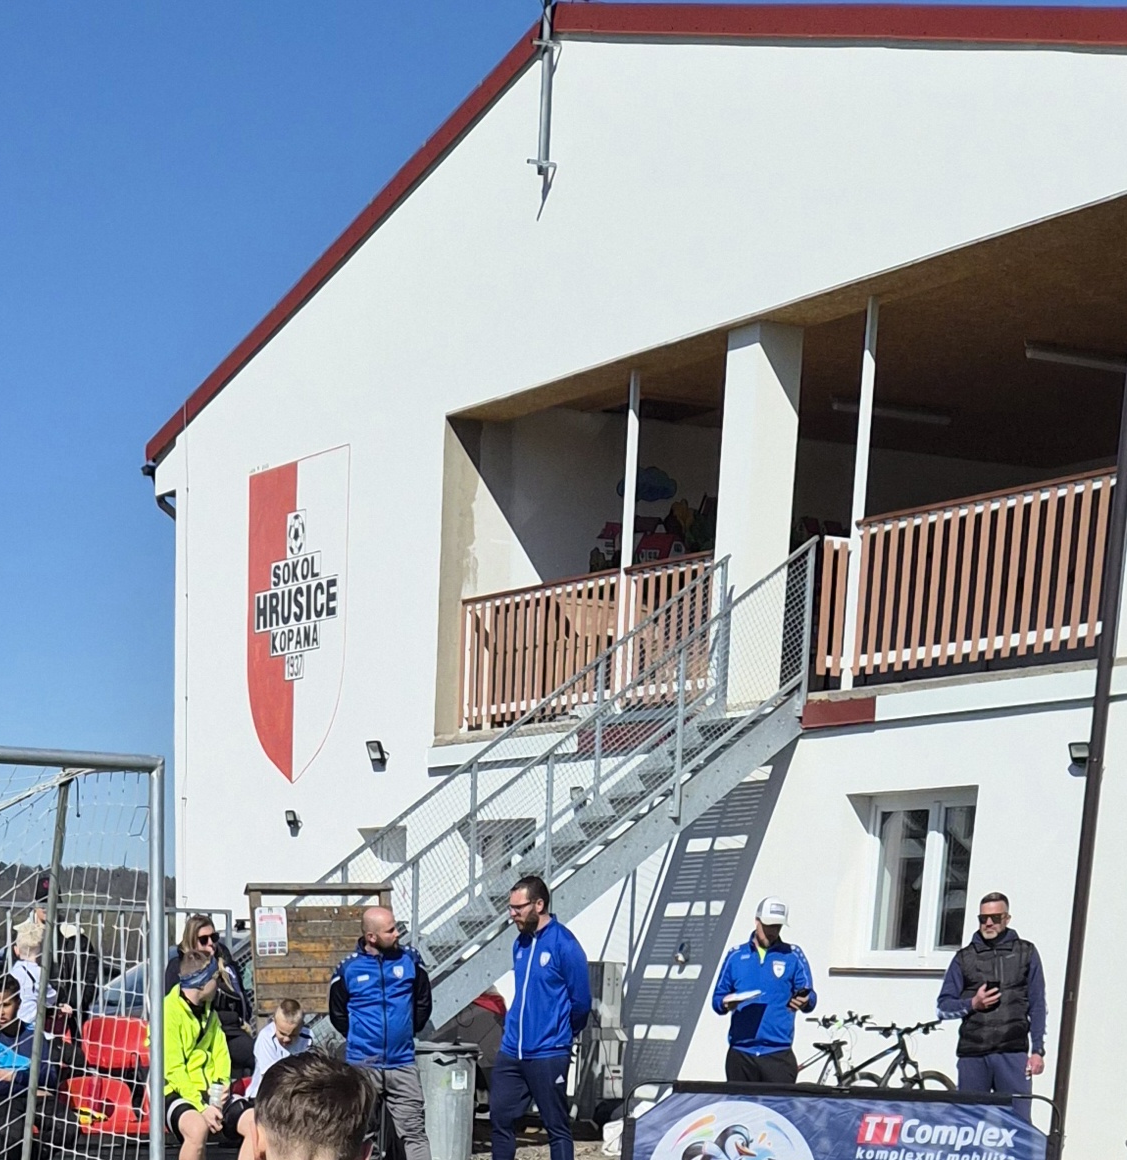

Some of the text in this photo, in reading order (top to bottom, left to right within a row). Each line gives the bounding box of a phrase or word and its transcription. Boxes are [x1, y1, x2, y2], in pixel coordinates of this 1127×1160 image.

[272, 554, 320, 588] SOKOL
[256, 578, 338, 631] HRUSICE
[271, 621, 319, 655] KOPANÁ
[286, 654, 304, 678] 1937
[863, 1115, 1018, 1151] TTComplex
